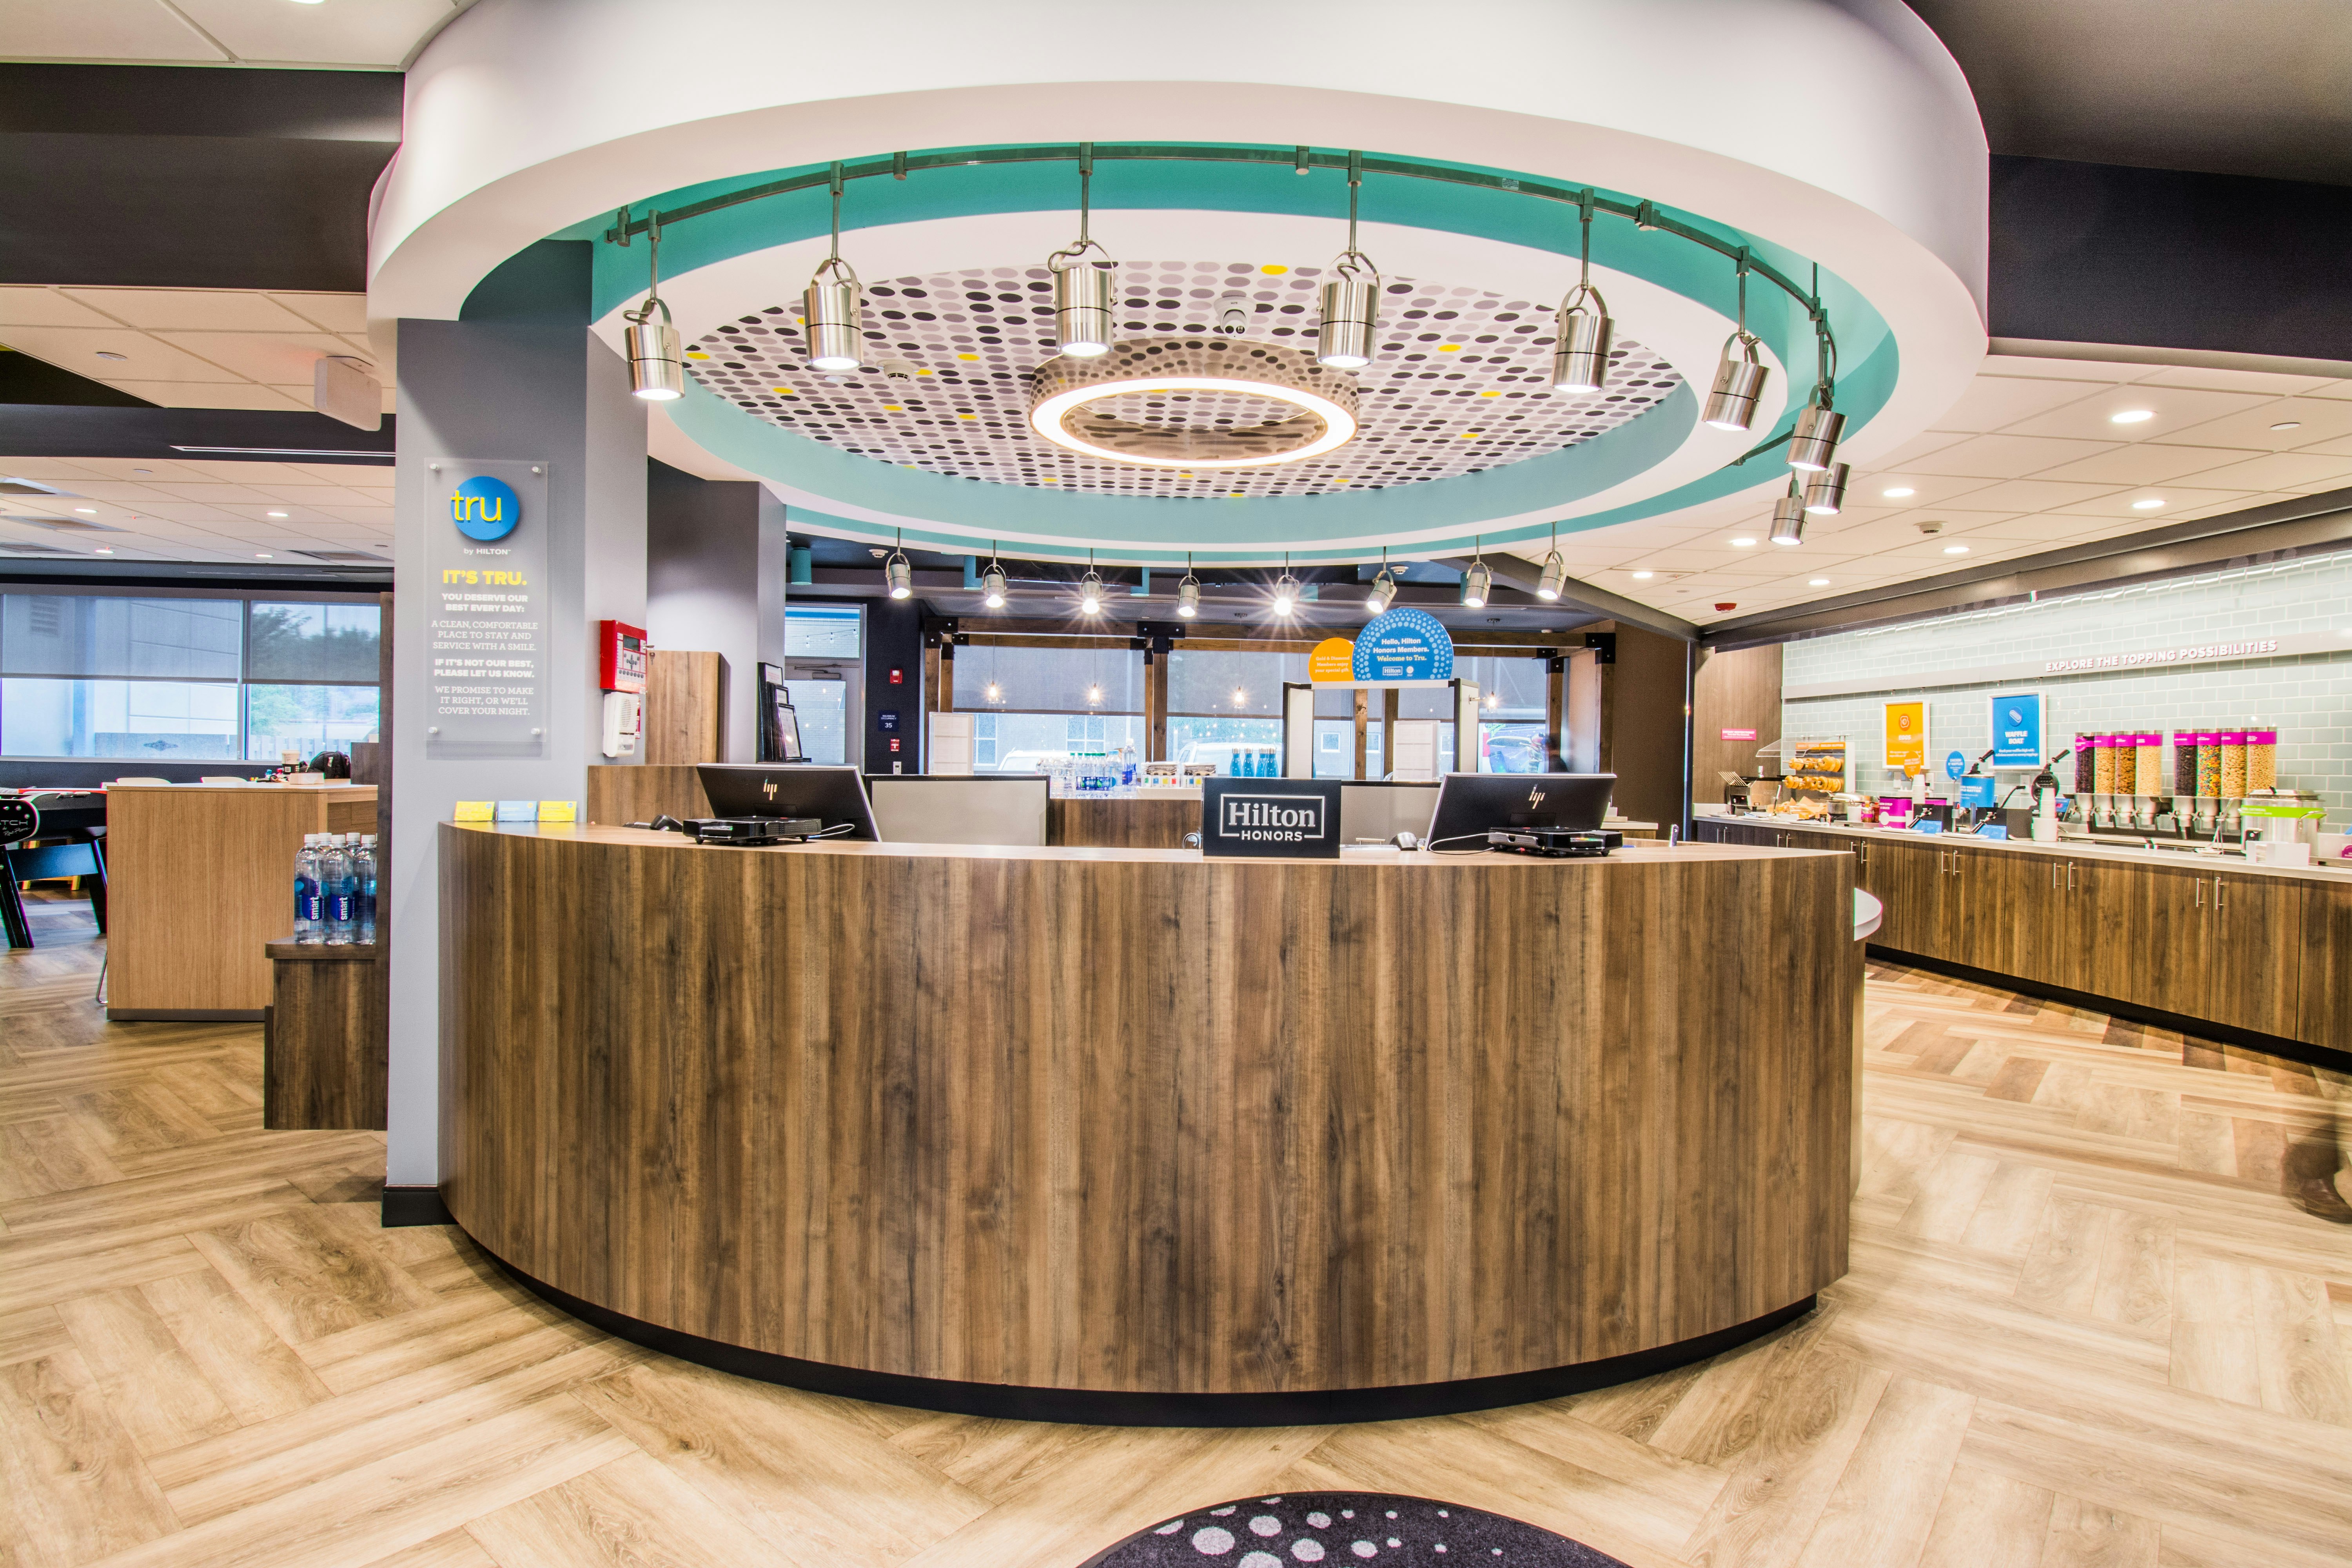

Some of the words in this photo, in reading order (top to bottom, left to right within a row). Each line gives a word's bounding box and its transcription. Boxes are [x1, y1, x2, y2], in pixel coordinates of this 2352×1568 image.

[451, 490, 502, 521] tru
[443, 570, 478, 584] IT'S
[483, 570, 527, 585] TRU.
[440, 621, 471, 629] CLEAN,
[472, 621, 538, 630] COMFORTABLE
[2045, 658, 2094, 672] EXPLORE
[2097, 655, 2119, 667] THE
[2121, 649, 2176, 666] TOPPING
[2180, 640, 2277, 660] POSSIBILITIES
[452, 697, 484, 705] RIGHT,
[1229, 802, 1316, 827] Hilton
[1241, 830, 1303, 841] HONORS
